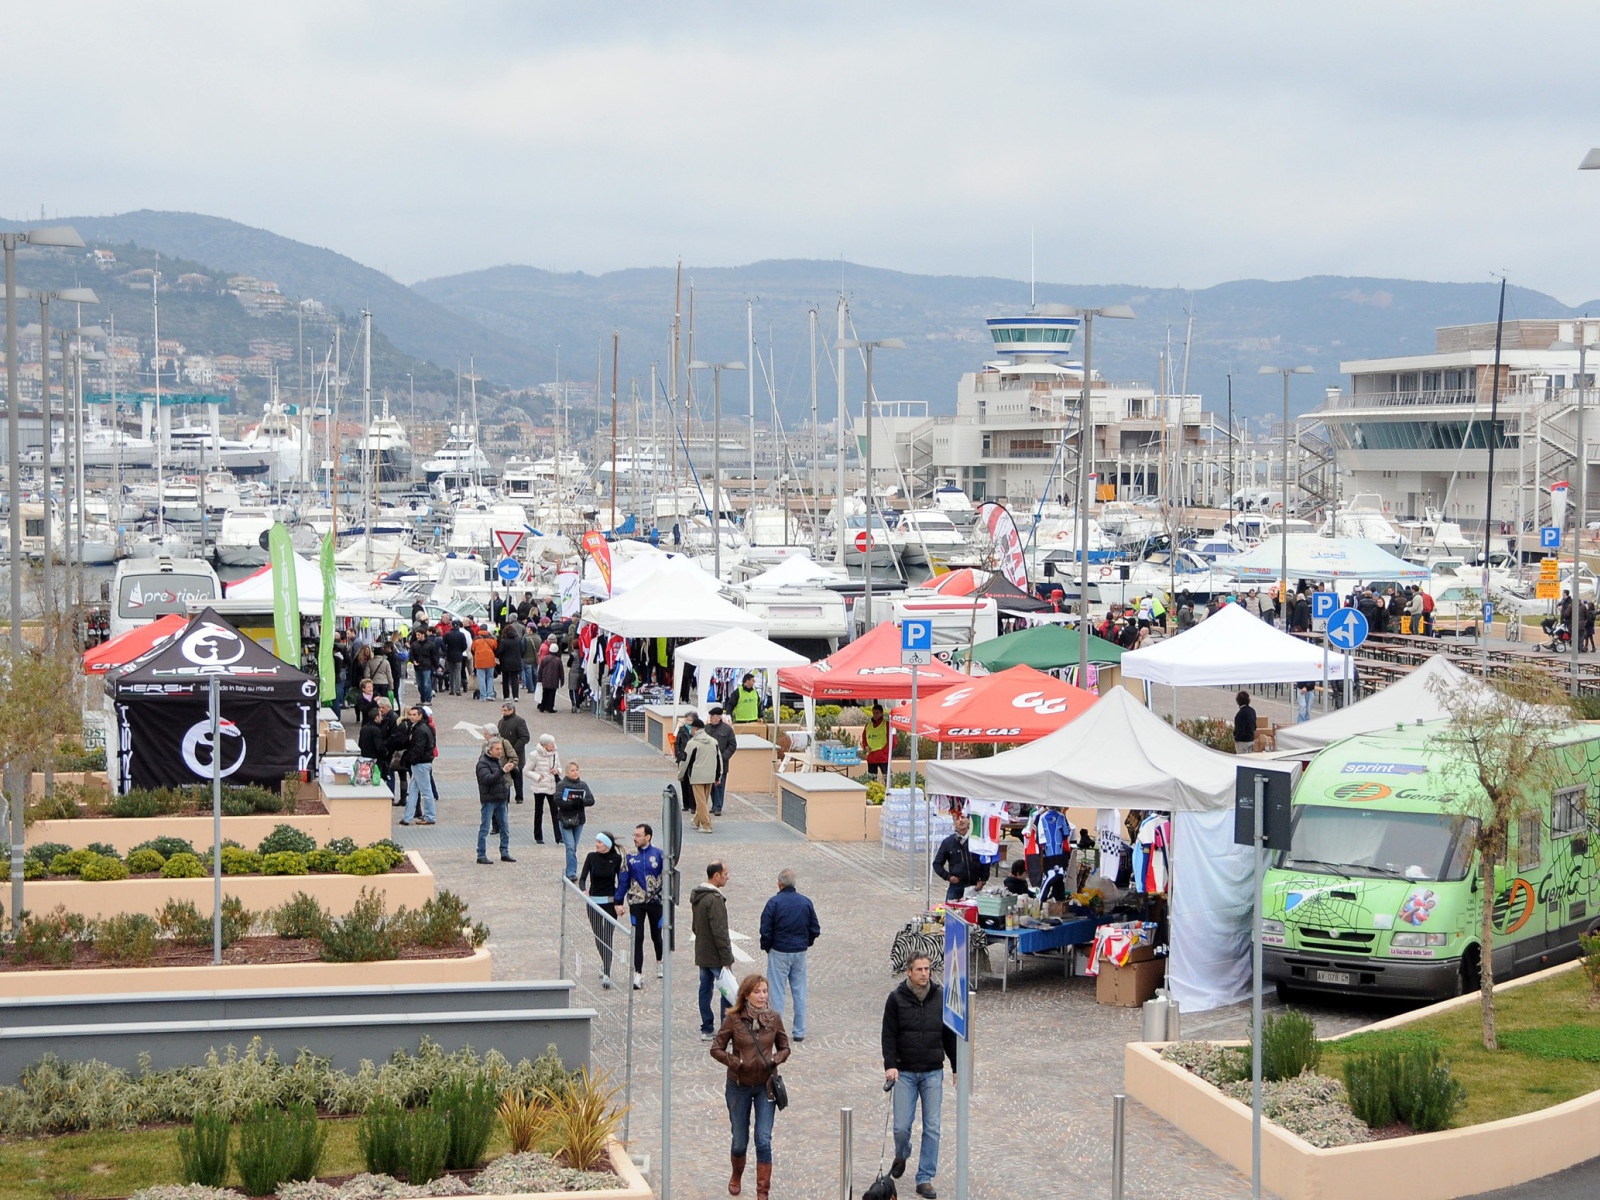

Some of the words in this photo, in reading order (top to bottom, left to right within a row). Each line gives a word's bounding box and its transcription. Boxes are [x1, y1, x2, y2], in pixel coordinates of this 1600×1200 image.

[1544, 530, 1557, 545] P
[1317, 595, 1333, 616] P
[907, 623, 926, 647] P
[118, 683, 194, 693] HERSH
[235, 684, 247, 693] Italy
[947, 727, 983, 736] GAS
[985, 727, 1021, 736] GAS
[1344, 763, 1395, 774] sprint
